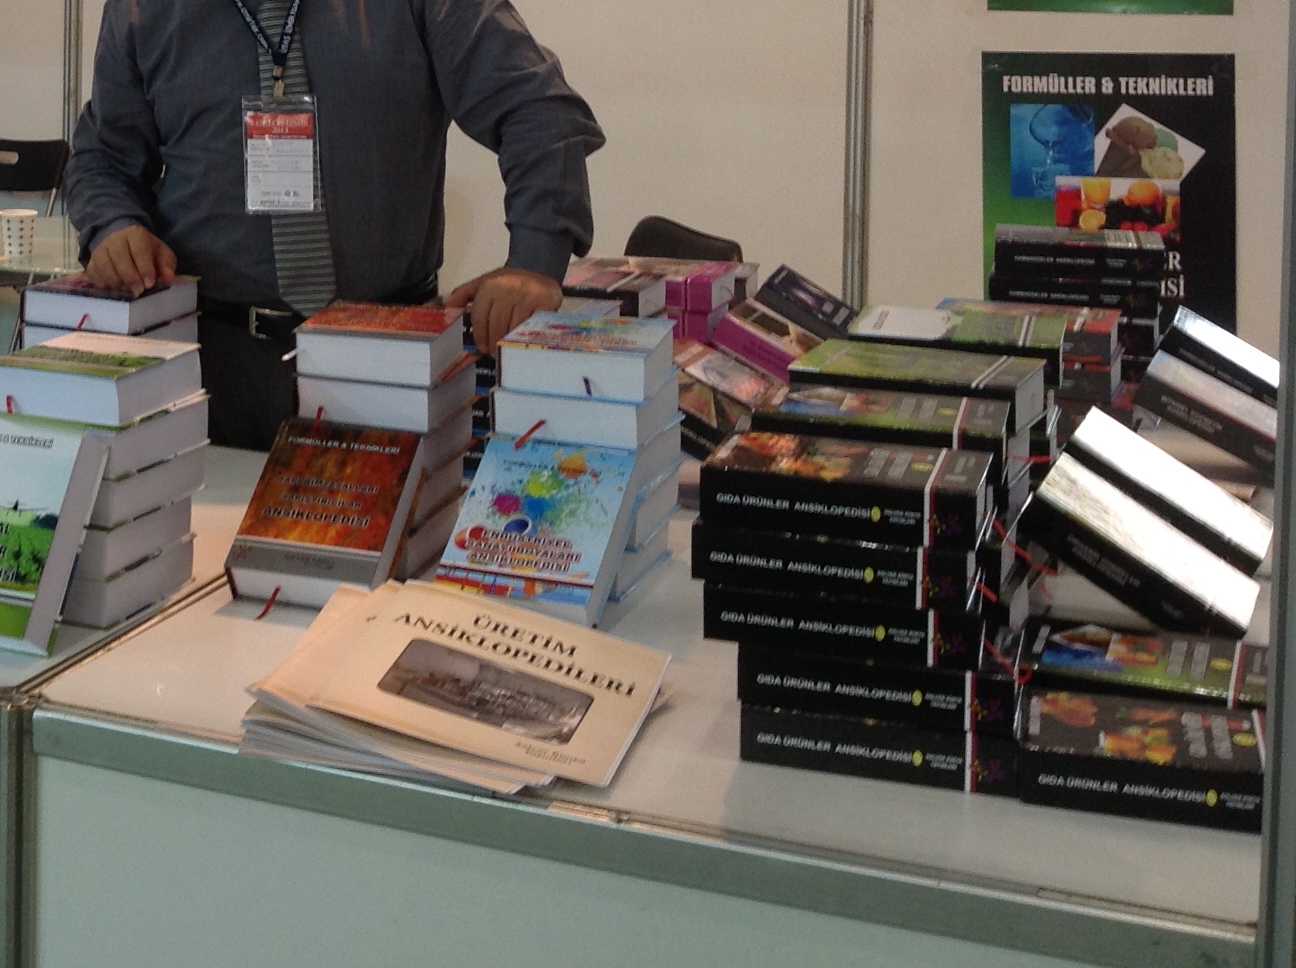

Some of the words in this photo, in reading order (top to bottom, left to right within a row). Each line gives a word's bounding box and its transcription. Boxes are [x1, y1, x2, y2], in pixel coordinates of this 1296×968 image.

[1003, 73, 1096, 94] FORMÜLLER
[1102, 78, 1114, 94] &
[1119, 74, 1214, 96] TEKNİKLERİ
[742, 495, 790, 510] ÜRÜNLER
[736, 553, 782, 569] ÜRÜNLER
[747, 612, 794, 628] ÜRÜNLER
[473, 614, 577, 658] ÜRETİM
[395, 612, 636, 697] ANSİKLOPEDİLERİ
